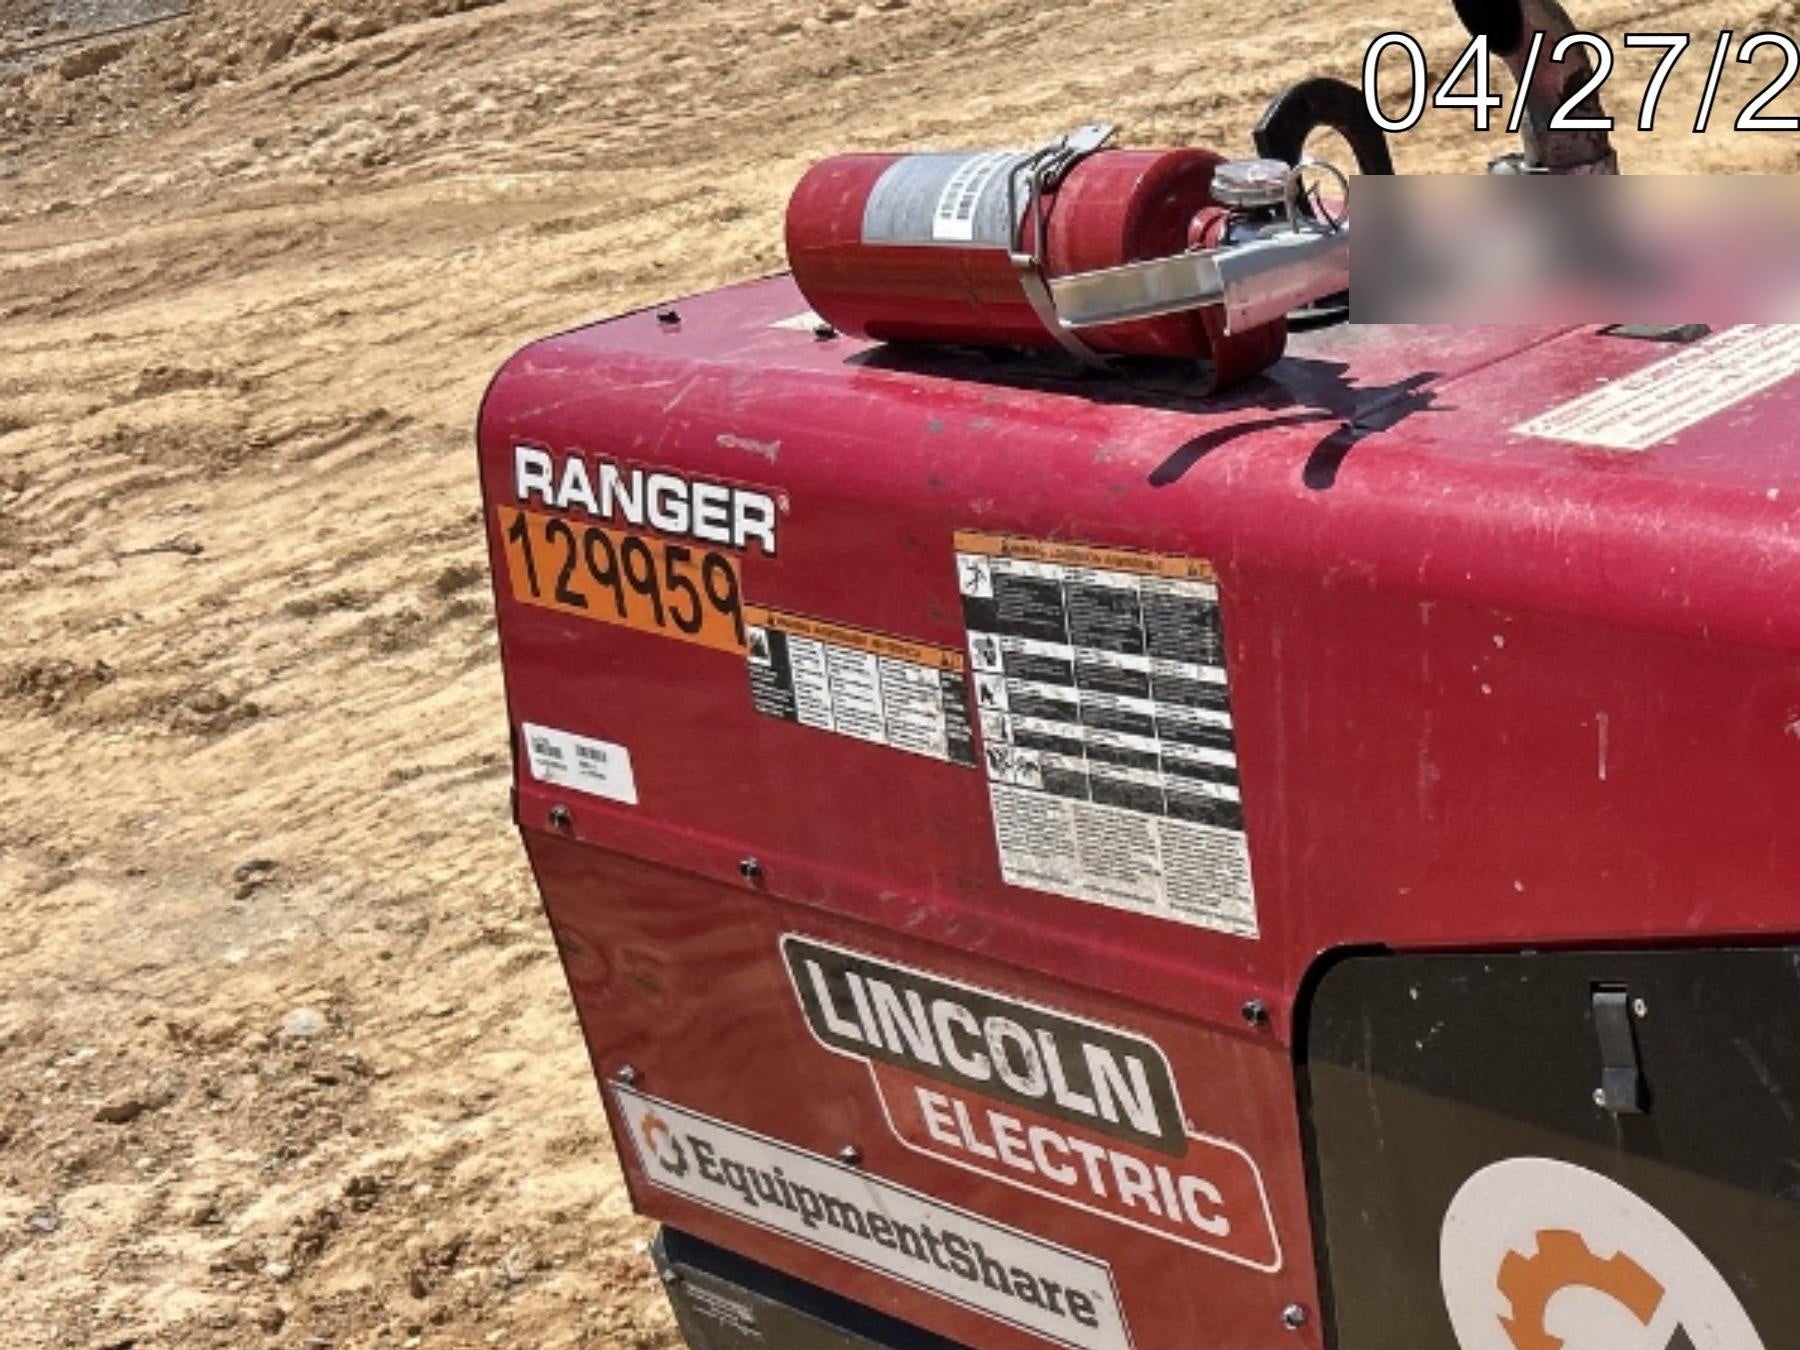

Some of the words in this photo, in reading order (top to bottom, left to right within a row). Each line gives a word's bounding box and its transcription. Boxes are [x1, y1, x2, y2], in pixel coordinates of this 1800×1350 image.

[514, 446, 777, 554] RANGER
[508, 510, 748, 647] 129959
[803, 958, 1163, 1139] LINCOLN
[687, 1134, 1100, 1329] EquipmentShare
[914, 1086, 1232, 1238] ELECTRIC
